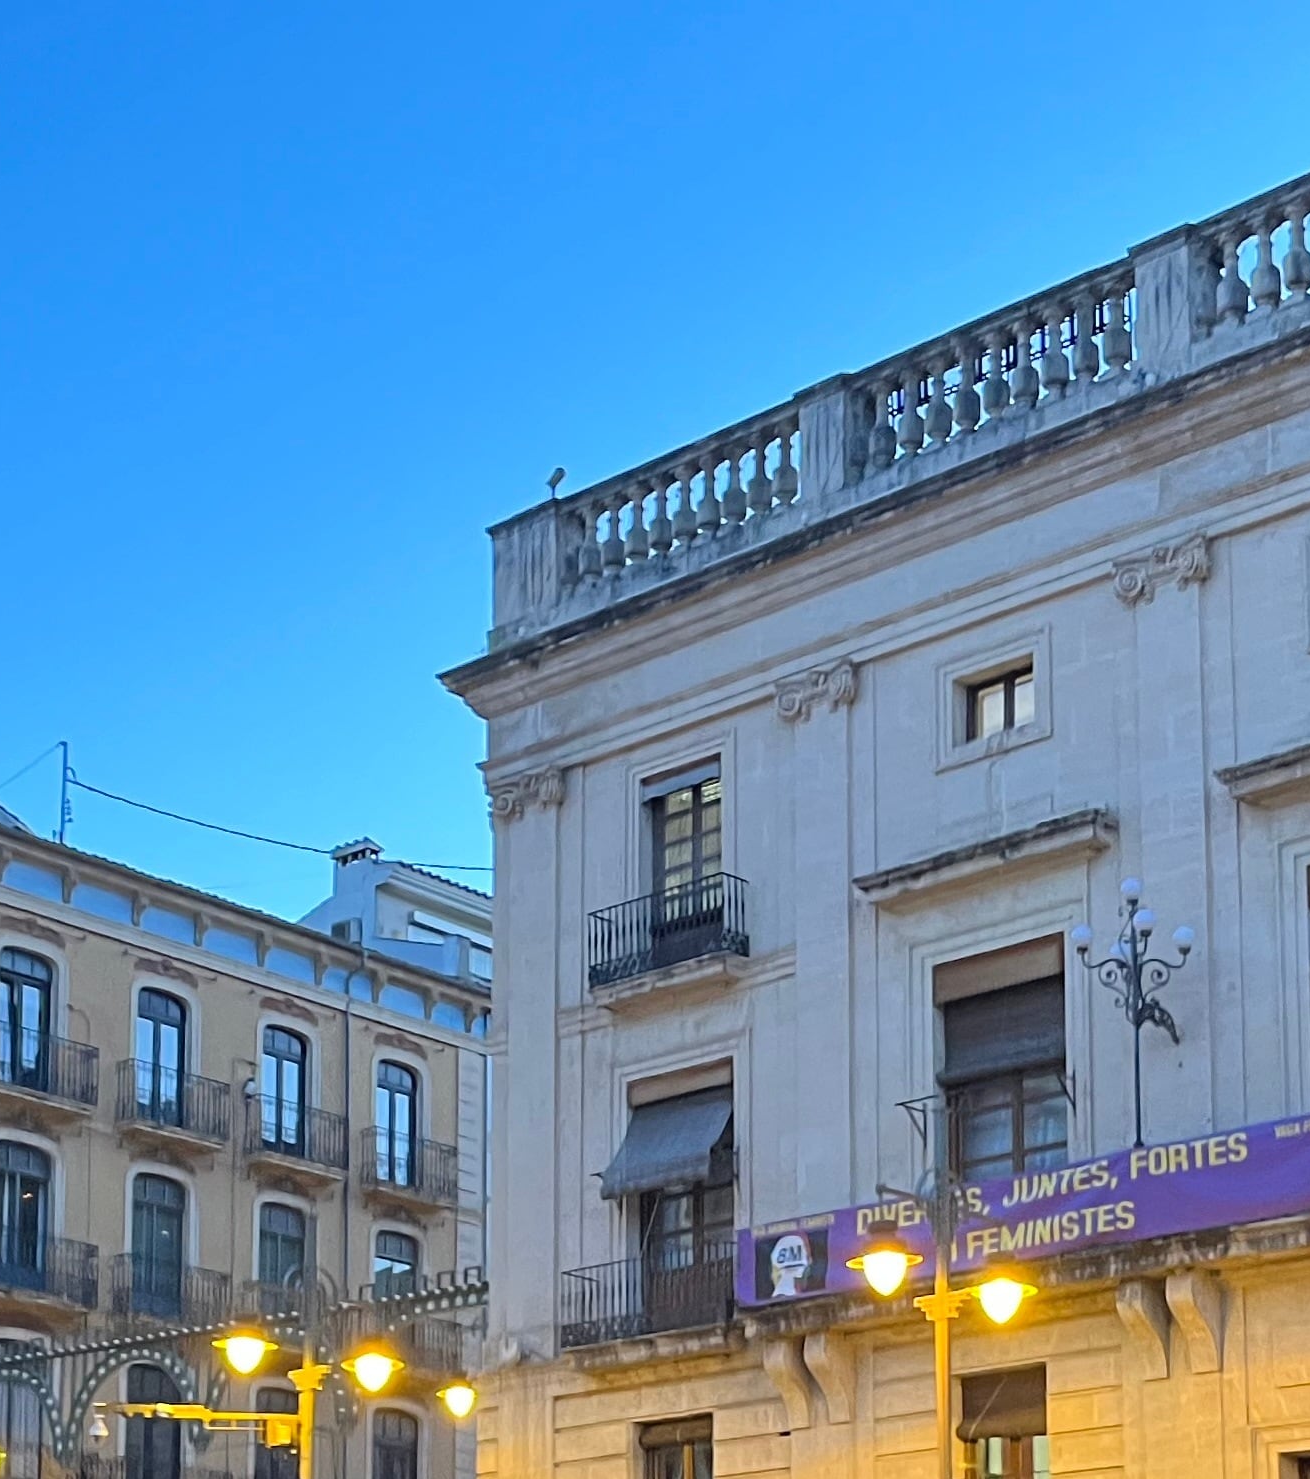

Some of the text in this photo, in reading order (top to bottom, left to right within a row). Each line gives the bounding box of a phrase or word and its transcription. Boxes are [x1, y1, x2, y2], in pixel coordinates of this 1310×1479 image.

[1002, 1160, 1118, 1208] JUNTES,
[1130, 1132, 1248, 1180] FORTES
[966, 1200, 1136, 1260] FEMINISTES
